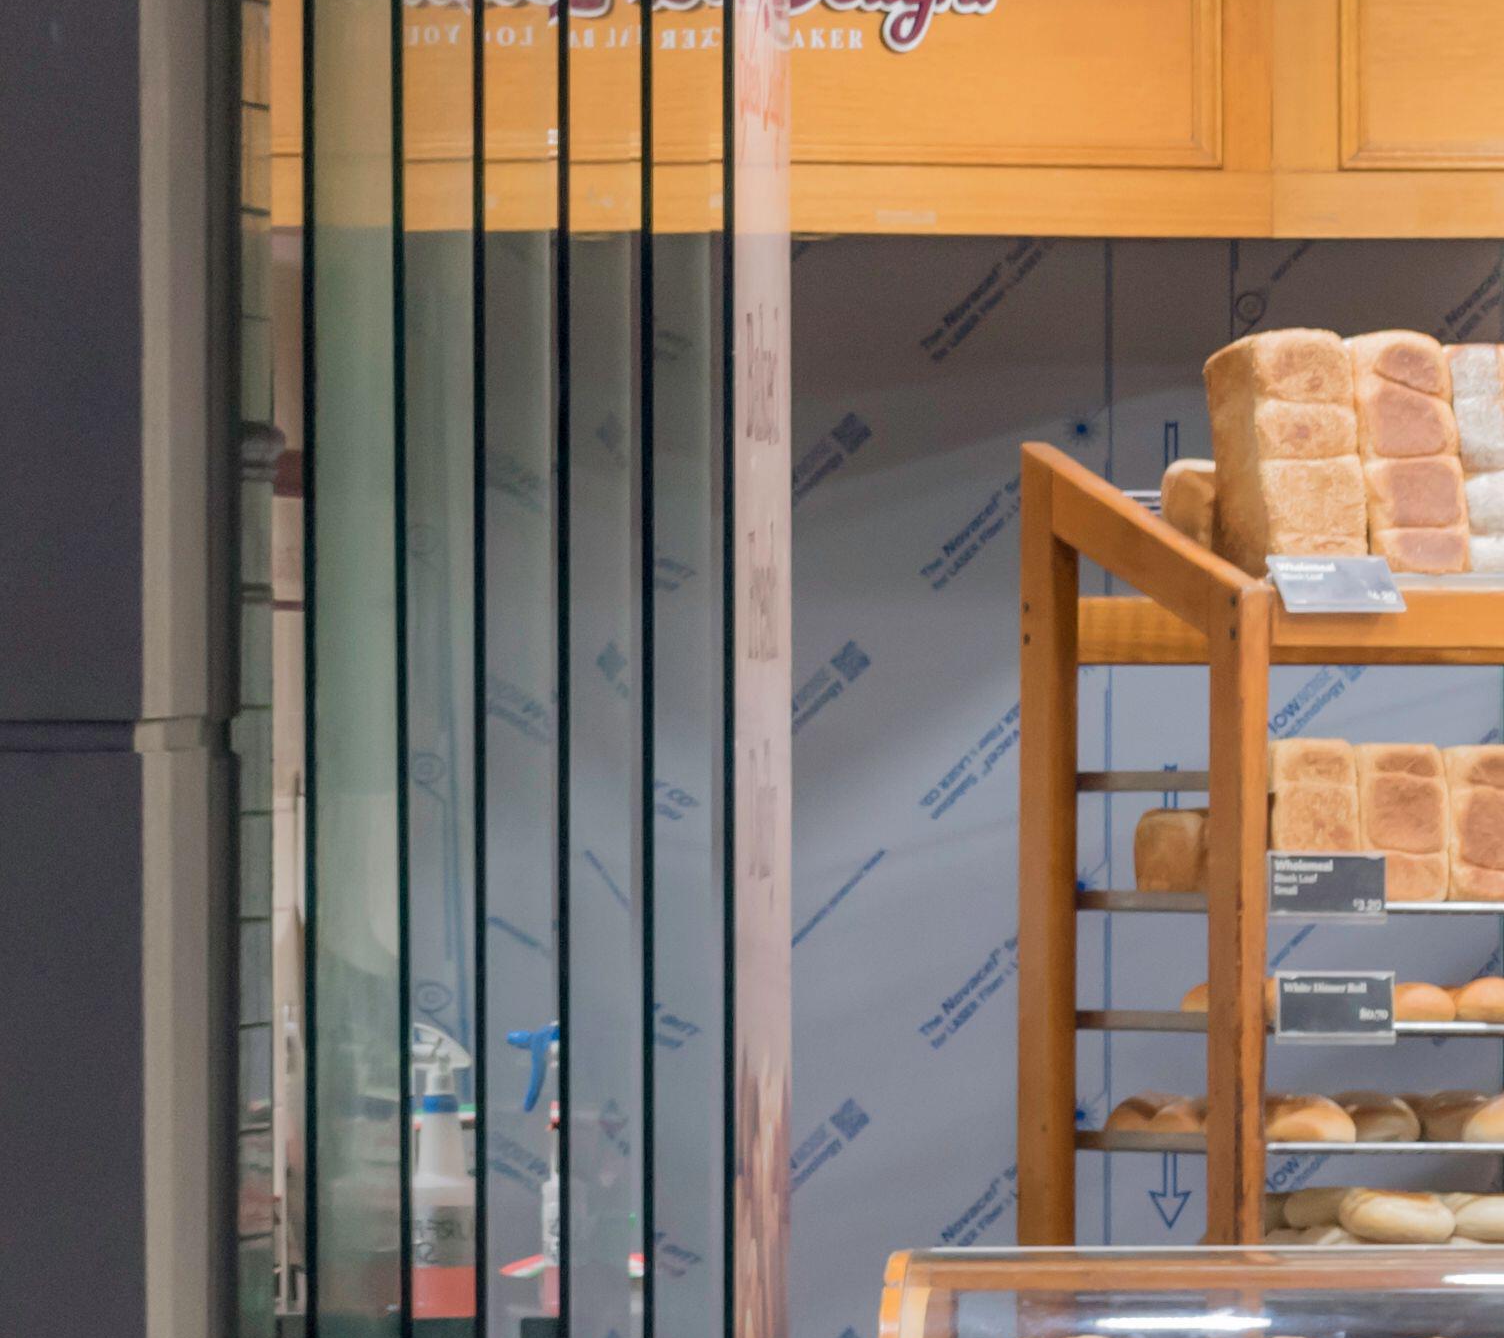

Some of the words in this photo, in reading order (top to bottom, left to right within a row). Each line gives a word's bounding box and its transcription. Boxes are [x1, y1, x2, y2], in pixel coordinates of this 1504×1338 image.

[792, 27, 864, 50] AKER
[1276, 563, 1336, 573] Wholemeal
[1274, 860, 1333, 872] Wholemeal
[1284, 983, 1312, 993] White
